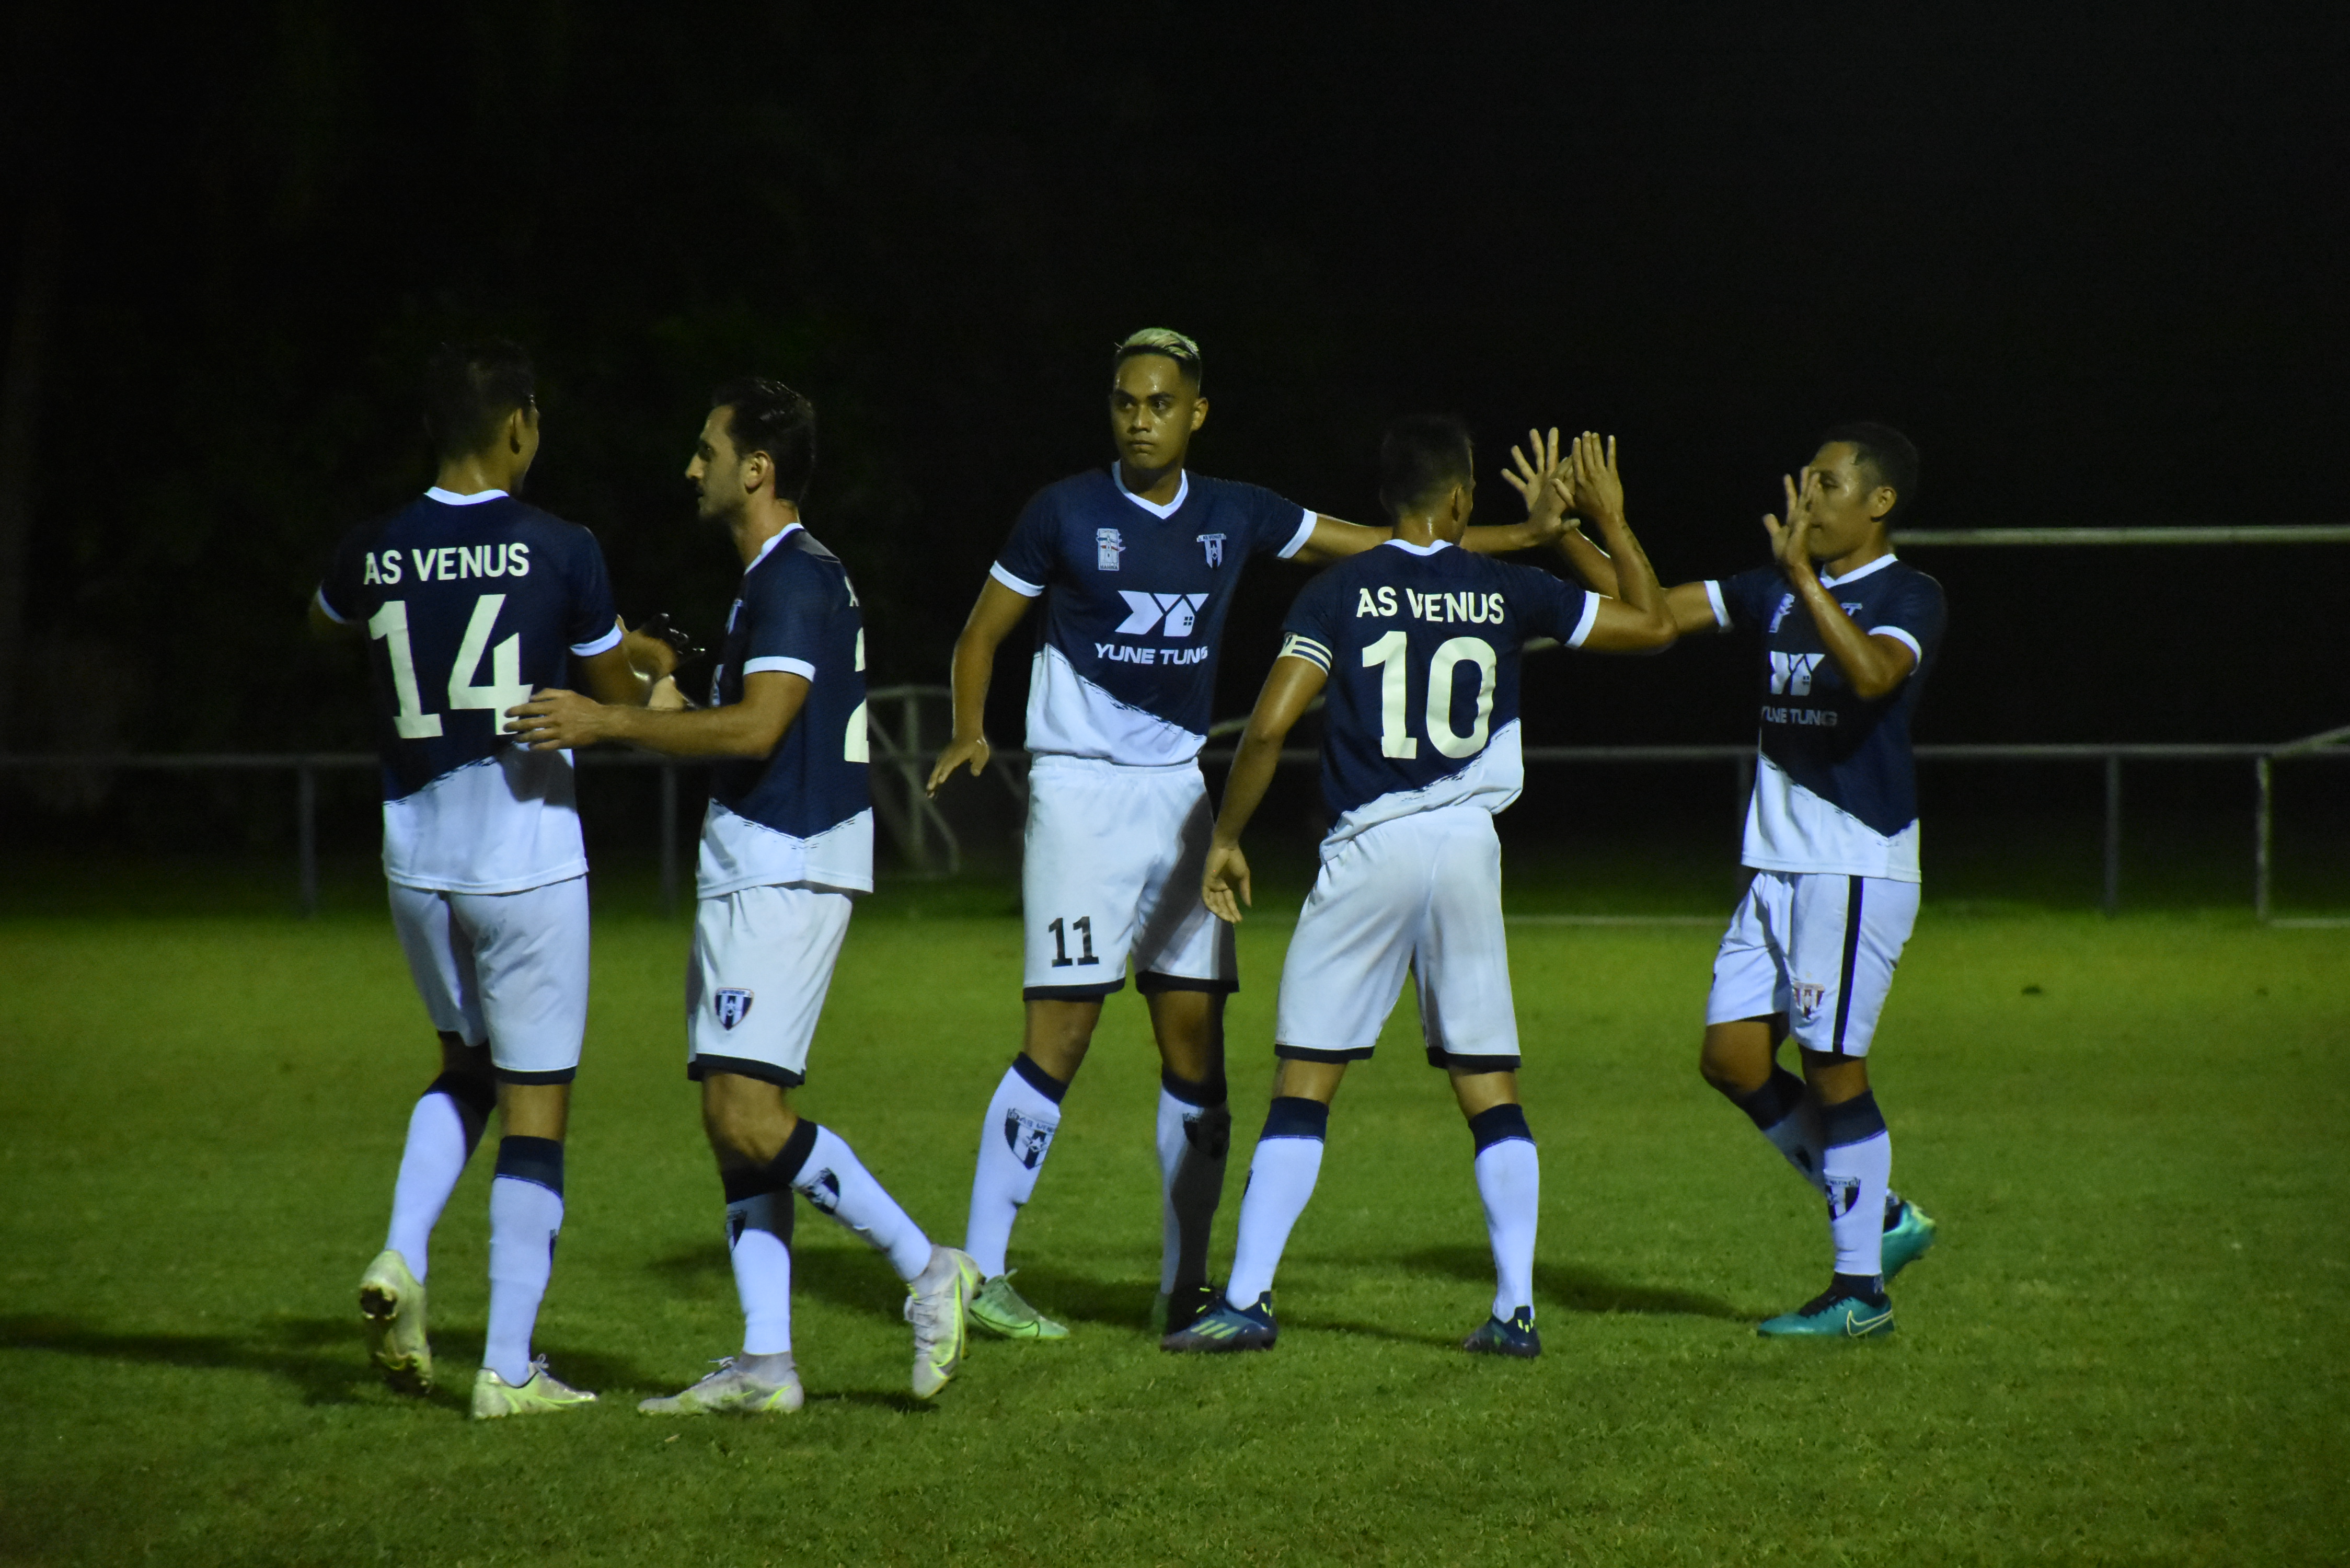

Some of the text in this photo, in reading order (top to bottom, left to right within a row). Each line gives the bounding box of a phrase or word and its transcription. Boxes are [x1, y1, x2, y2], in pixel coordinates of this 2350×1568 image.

[364, 543, 529, 584] AS VENUS
[1356, 586, 1504, 624] AS VENUS
[368, 594, 534, 739] 14
[1095, 643, 1156, 664] YUNE
[1362, 631, 1496, 759] 10
[1789, 708, 1837, 725] TUNG
[1049, 916, 1099, 967] 11
